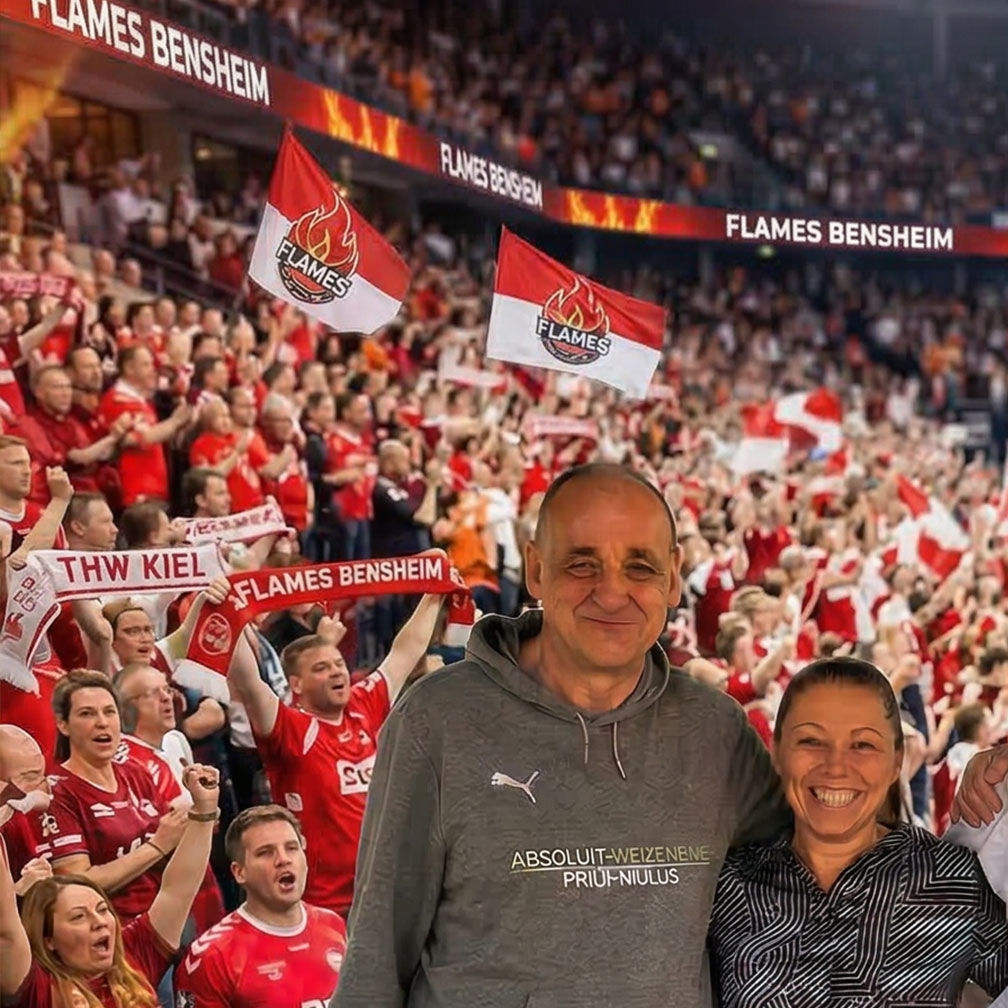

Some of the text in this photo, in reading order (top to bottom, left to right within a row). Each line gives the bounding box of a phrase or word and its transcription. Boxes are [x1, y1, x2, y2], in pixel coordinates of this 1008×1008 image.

[150, 20, 270, 105] BENSHEIM
[726, 213, 953, 250] FLAMES BENSHEIM
[276, 239, 350, 297] FLAMES
[537, 320, 610, 355] FLAMES
[57, 552, 206, 584] THW KIEL
[233, 568, 333, 605] FLAMES
[339, 557, 443, 587] BENSHEIM
